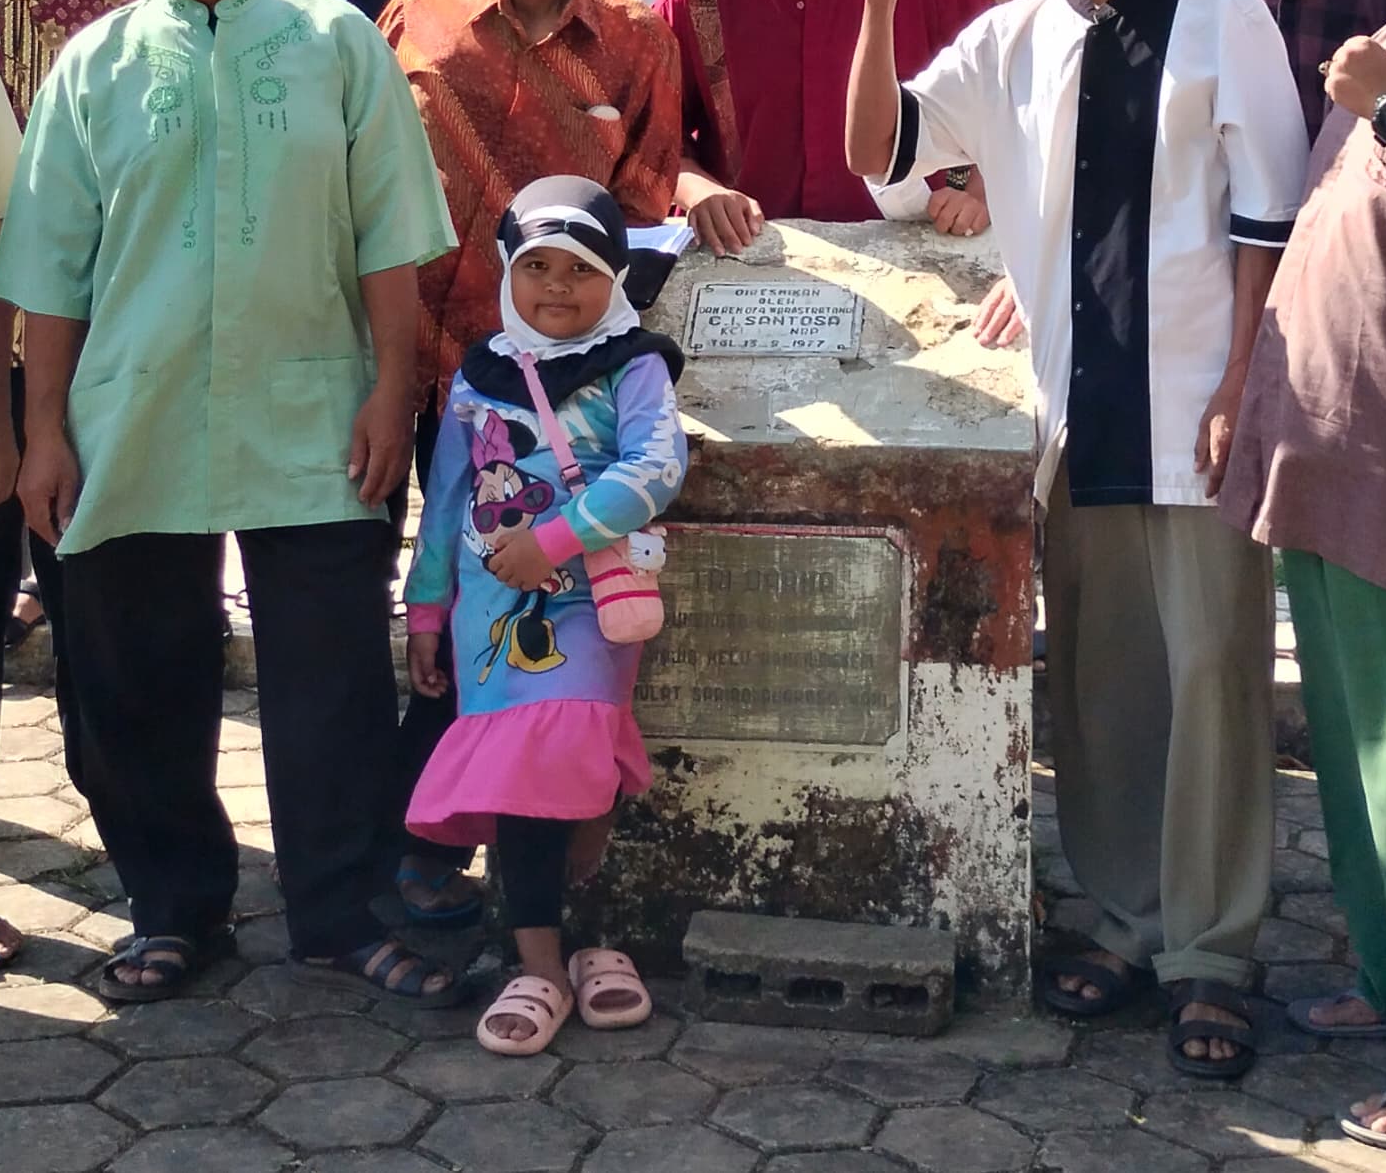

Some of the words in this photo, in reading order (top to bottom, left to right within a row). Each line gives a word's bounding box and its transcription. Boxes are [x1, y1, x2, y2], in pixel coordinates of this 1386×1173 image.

[734, 288, 821, 297] DIRESMIKAN
[758, 297, 795, 305] OLEH
[744, 315, 841, 326] SANTOSA
